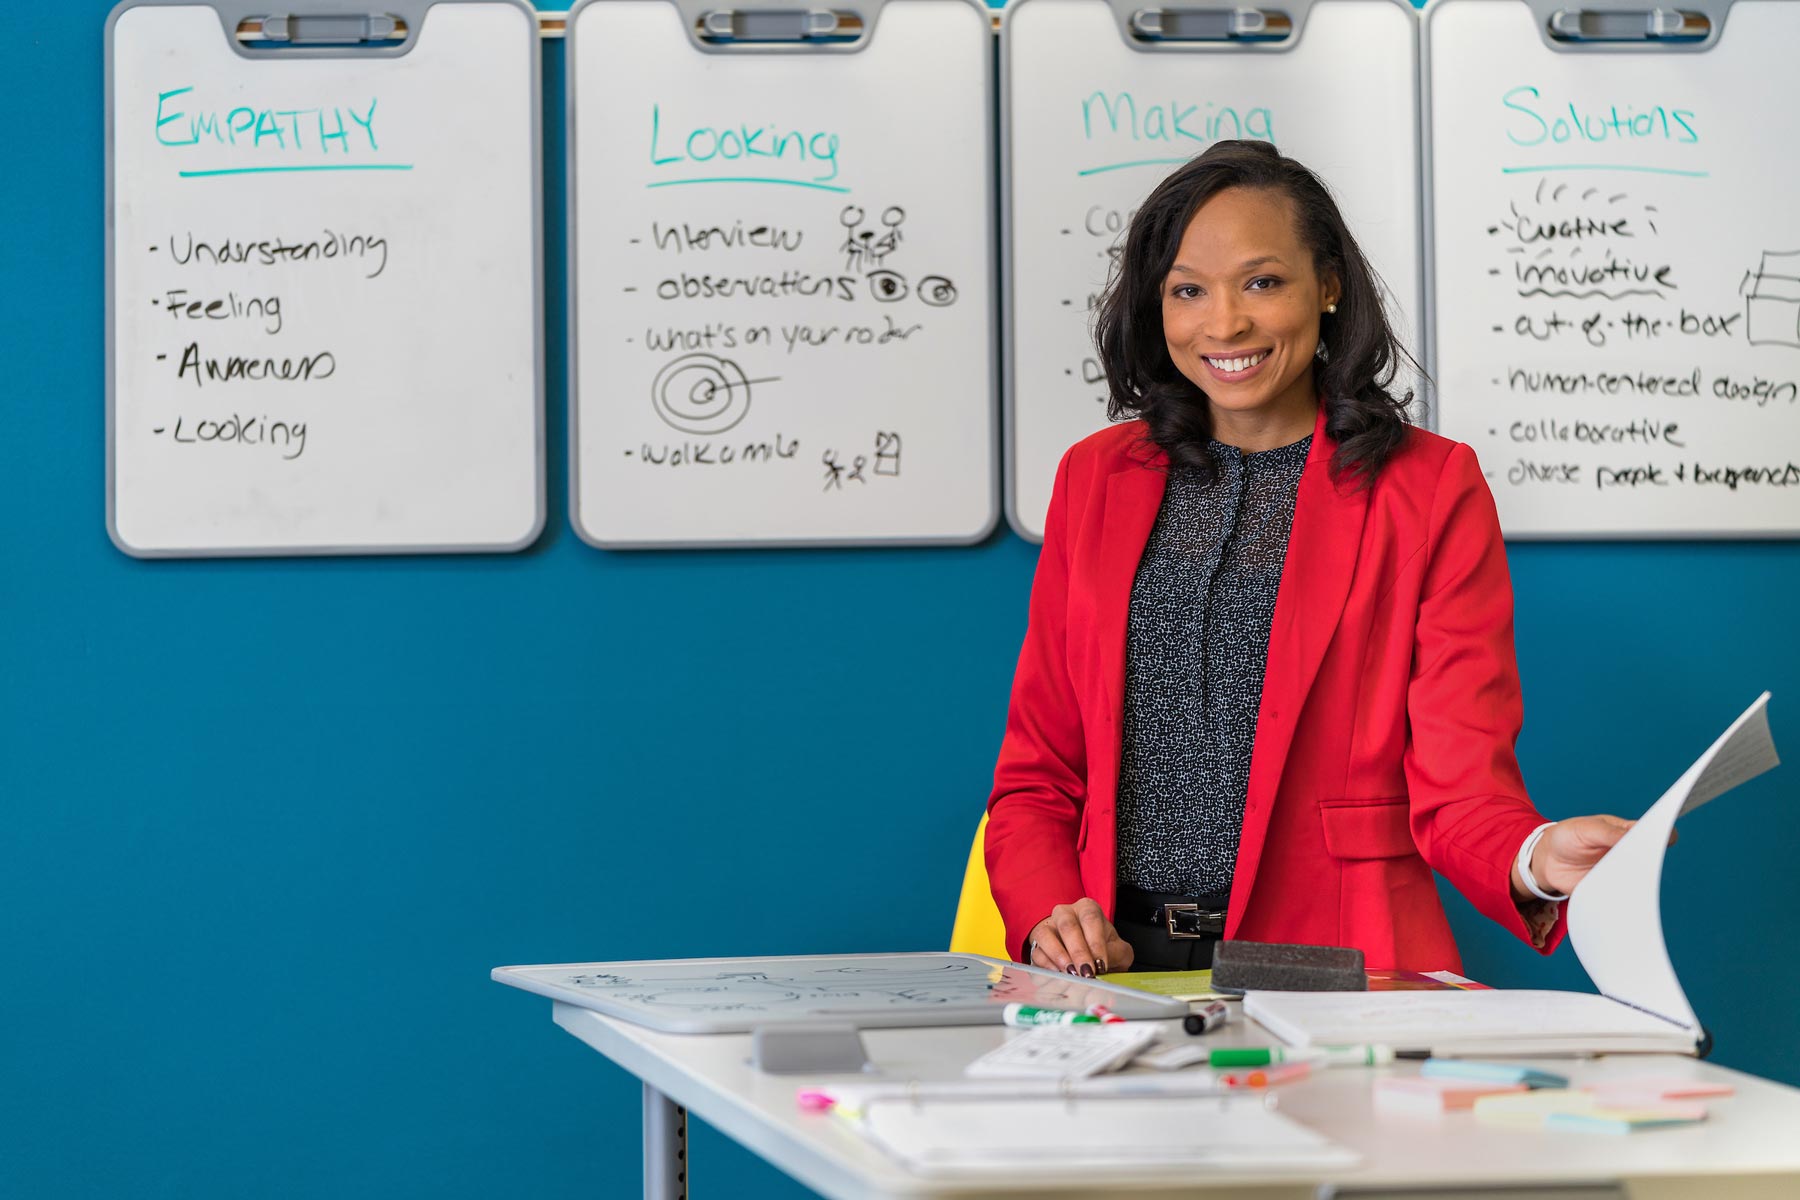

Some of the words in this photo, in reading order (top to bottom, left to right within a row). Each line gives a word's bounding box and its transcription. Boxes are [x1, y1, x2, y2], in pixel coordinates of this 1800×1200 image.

[155, 86, 377, 153] EMPATHY
[1082, 91, 1274, 144] Making
[1503, 86, 1698, 145] Solutions
[650, 104, 838, 181] Looking
[170, 229, 386, 278] Understanding
[653, 220, 801, 252] Interview
[657, 271, 855, 300] observations
[166, 290, 281, 334] Feeling
[178, 341, 335, 386] Awareness
[174, 414, 305, 459] Looking
[1510, 419, 1684, 447] collaborative
